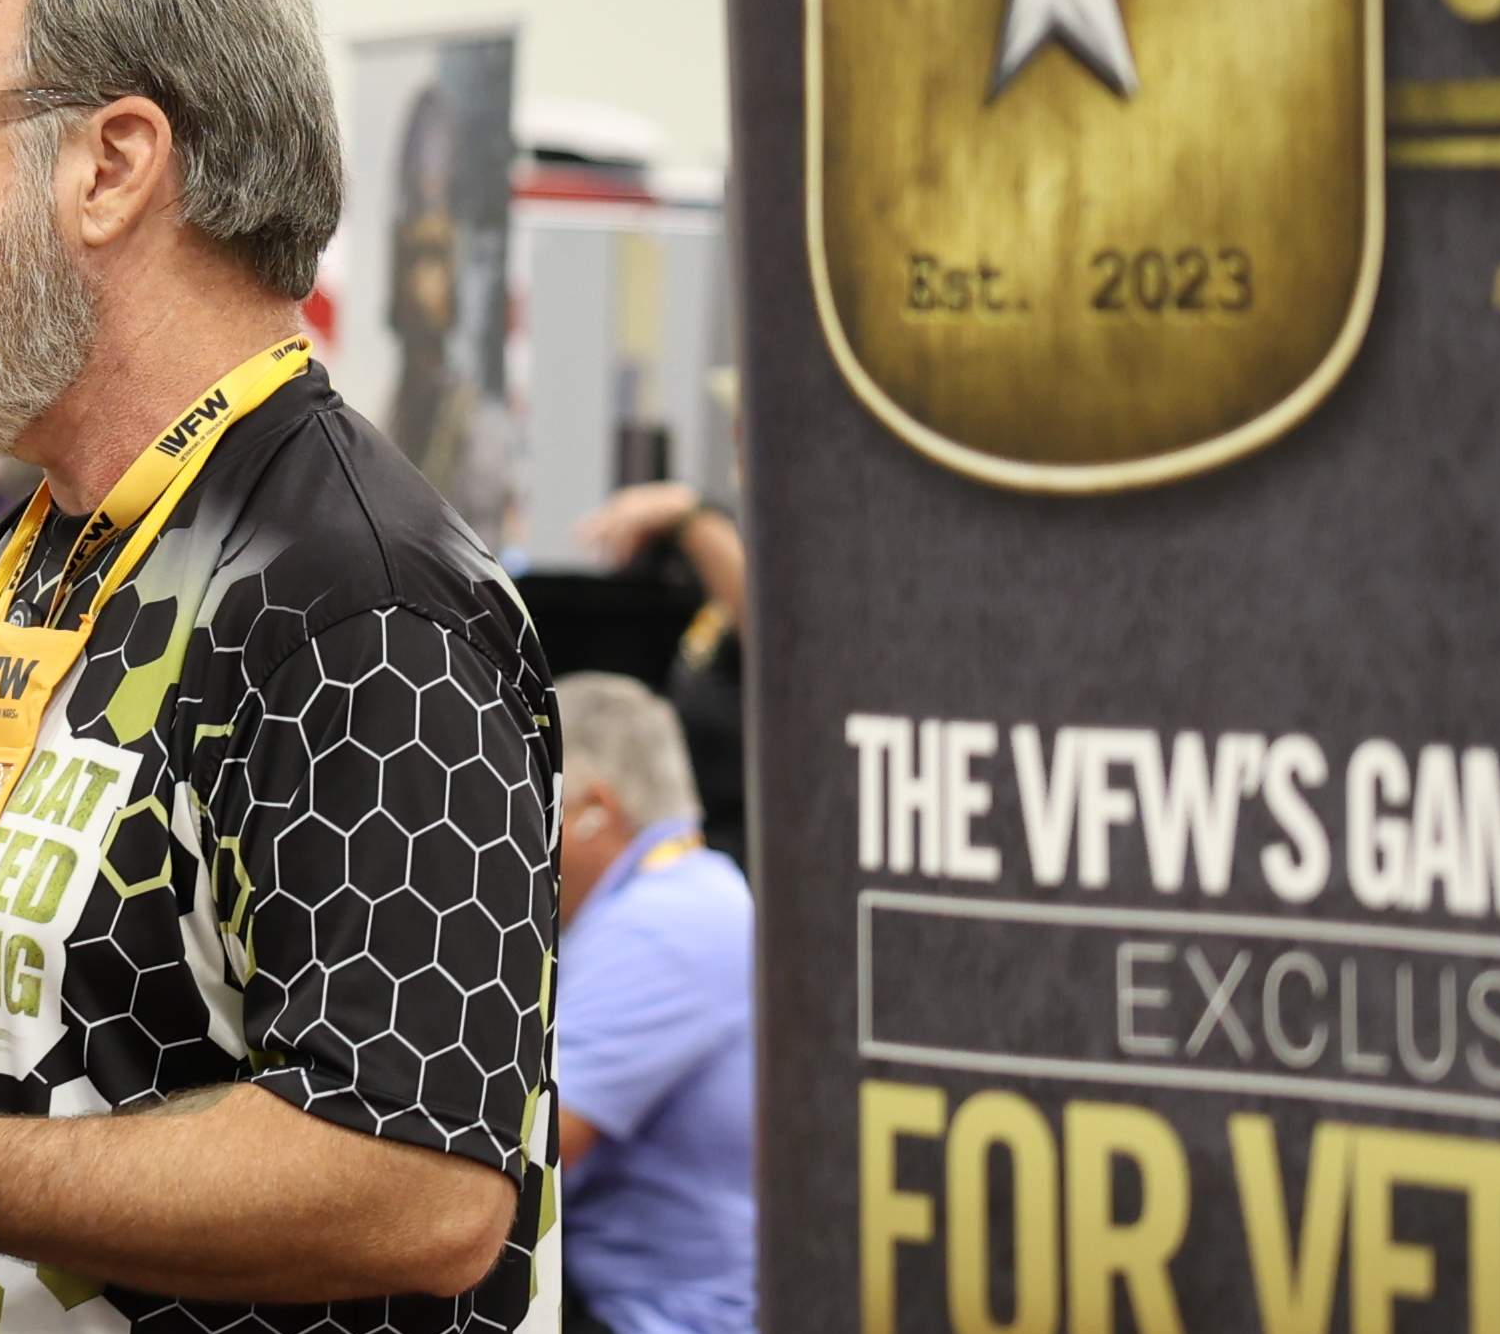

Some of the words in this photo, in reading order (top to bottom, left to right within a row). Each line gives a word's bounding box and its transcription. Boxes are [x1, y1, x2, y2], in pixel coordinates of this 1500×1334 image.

[905, 251, 1030, 312] Est.
[1090, 247, 1256, 313] 2023
[155, 388, 230, 458] VFW
[845, 713, 1005, 885] THE
[1014, 723, 1333, 911] VFW'S
